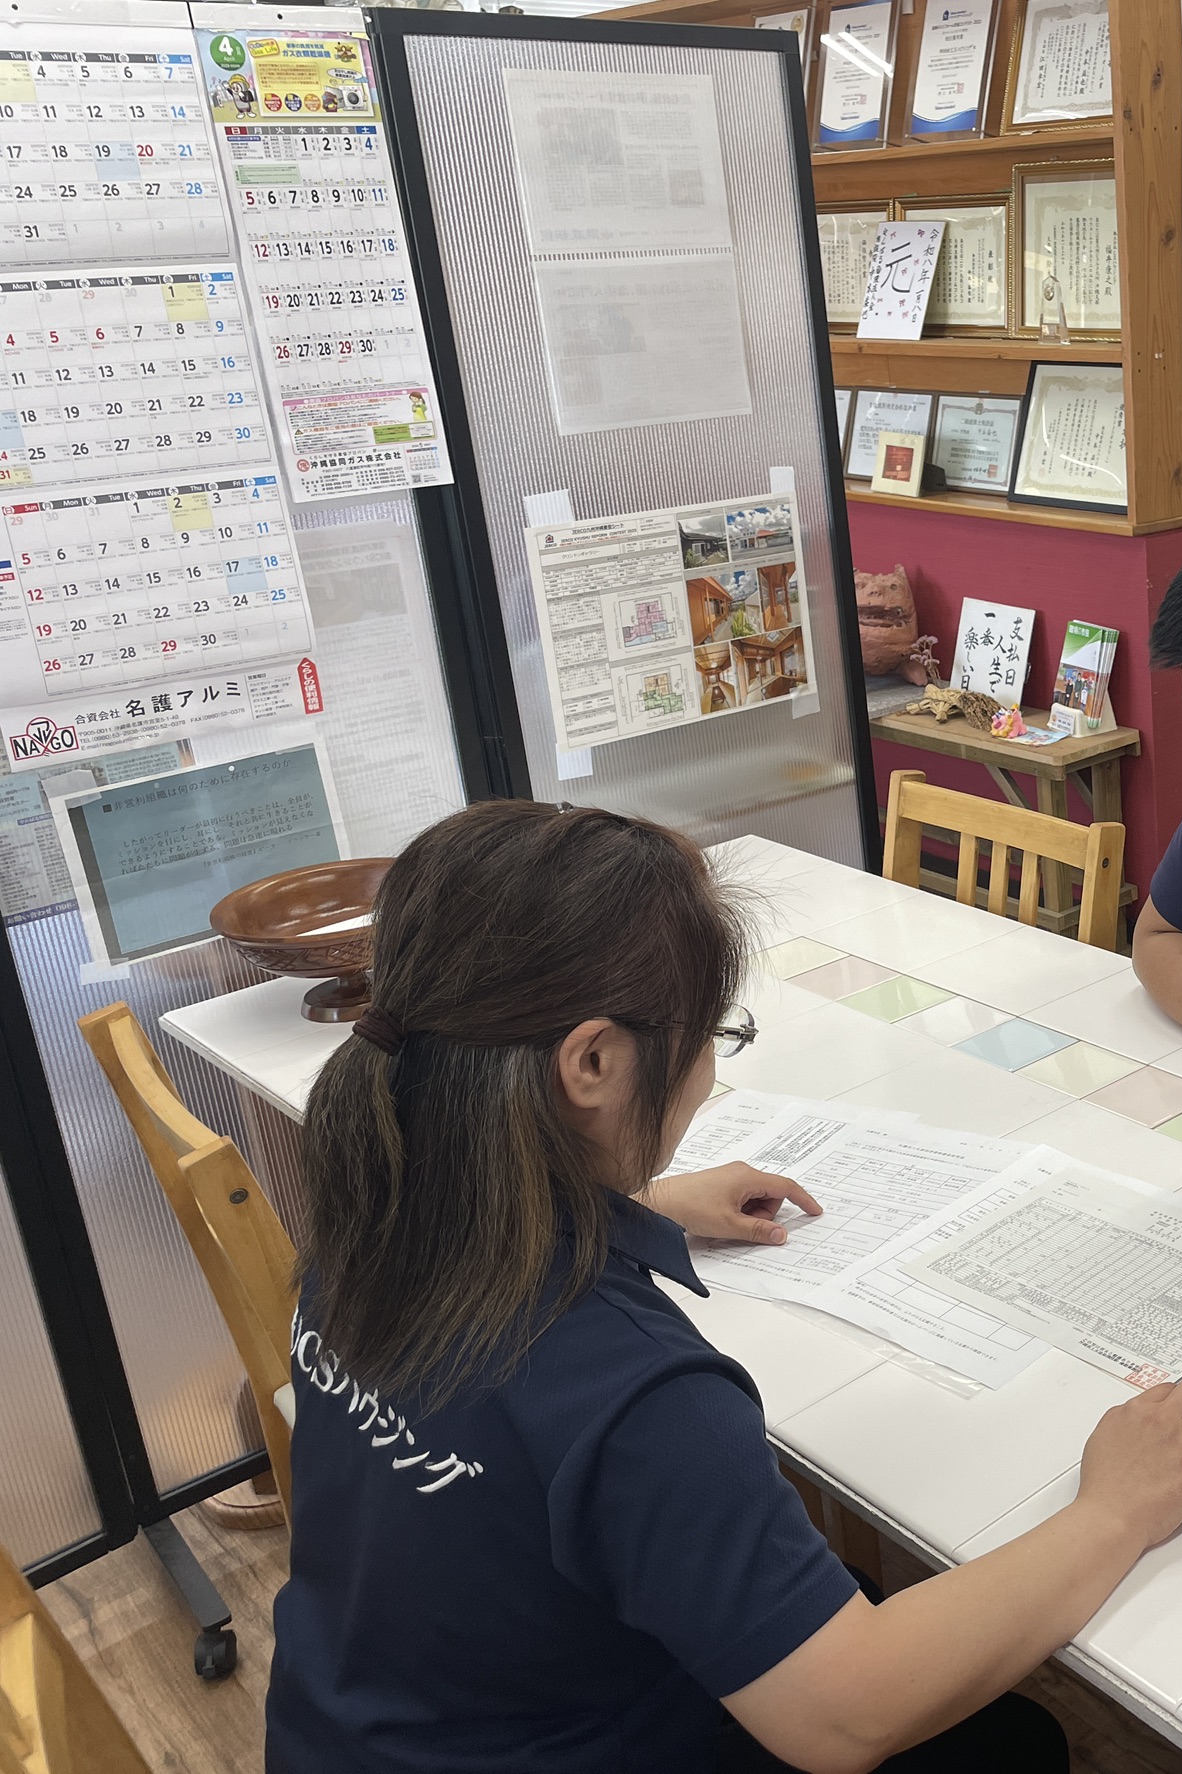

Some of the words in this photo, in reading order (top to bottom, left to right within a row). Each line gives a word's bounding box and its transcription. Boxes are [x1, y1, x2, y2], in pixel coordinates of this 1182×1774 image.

[219, 37, 234, 57] 4
[301, 138, 308, 152] 1
[322, 137, 331, 151] 2
[343, 137, 352, 151] 3
[364, 136, 374, 151] 4
[245, 192, 255, 206] 5
[267, 191, 277, 205] 6
[288, 191, 297, 204] 7
[310, 190, 320, 204] 8
[332, 189, 341, 203] 9
[351, 189, 364, 202] 10
[372, 188, 385, 202] 11
[134, 502, 139, 514] 1
[175, 497, 182, 509] 2
[214, 493, 222, 504] 3
[252, 488, 260, 500] 4
[22, 553, 31, 566] 5
[57, 548, 66, 561] 6
[99, 543, 107, 555] 7
[141, 538, 150, 550] 8
[182, 532, 190, 544] 9
[218, 527, 233, 539] 10
[257, 522, 269, 534] 11
[27, 589, 44, 602] 12
[63, 584, 79, 597] 13
[105, 578, 121, 590] 14
[146, 572, 161, 585] 15
[186, 567, 201, 579] 16
[226, 561, 240, 574] 17
[264, 556, 278, 568] 18
[37, 625, 53, 637] 19
[70, 620, 87, 632] 20
[113, 613, 128, 626] 21
[154, 607, 170, 619] 22
[194, 601, 210, 613] 23
[233, 595, 249, 607] 24
[271, 589, 287, 602] 25
[1005, 616, 1024, 687] 支払日
[75, 708, 121, 725] 合資会社
[125, 681, 241, 718] 名護アルミ
